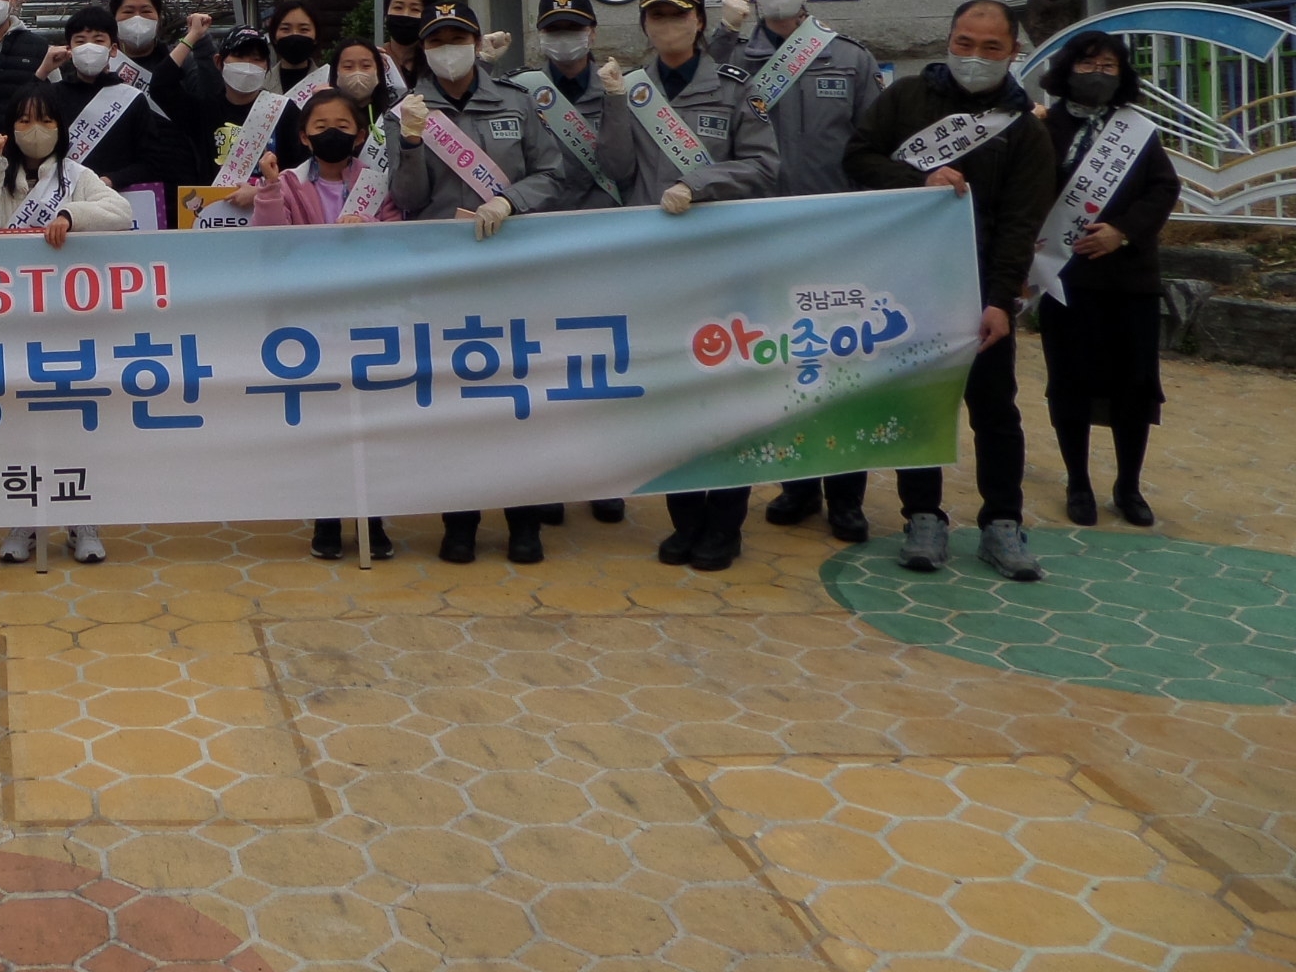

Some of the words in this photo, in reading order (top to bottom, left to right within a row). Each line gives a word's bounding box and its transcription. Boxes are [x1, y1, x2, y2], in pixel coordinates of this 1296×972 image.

[787, 37, 822, 76] 학교폭력
[656, 107, 699, 150] 학교폭력
[917, 124, 989, 170] 아름다운
[1089, 120, 1131, 174] 학교폭력
[1064, 175, 1093, 208] 없는
[1091, 144, 1138, 202] 아름다운
[796, 289, 866, 312] 경남교육
[692, 307, 909, 385] 아이좋아
[245, 314, 645, 427] 우리학교
